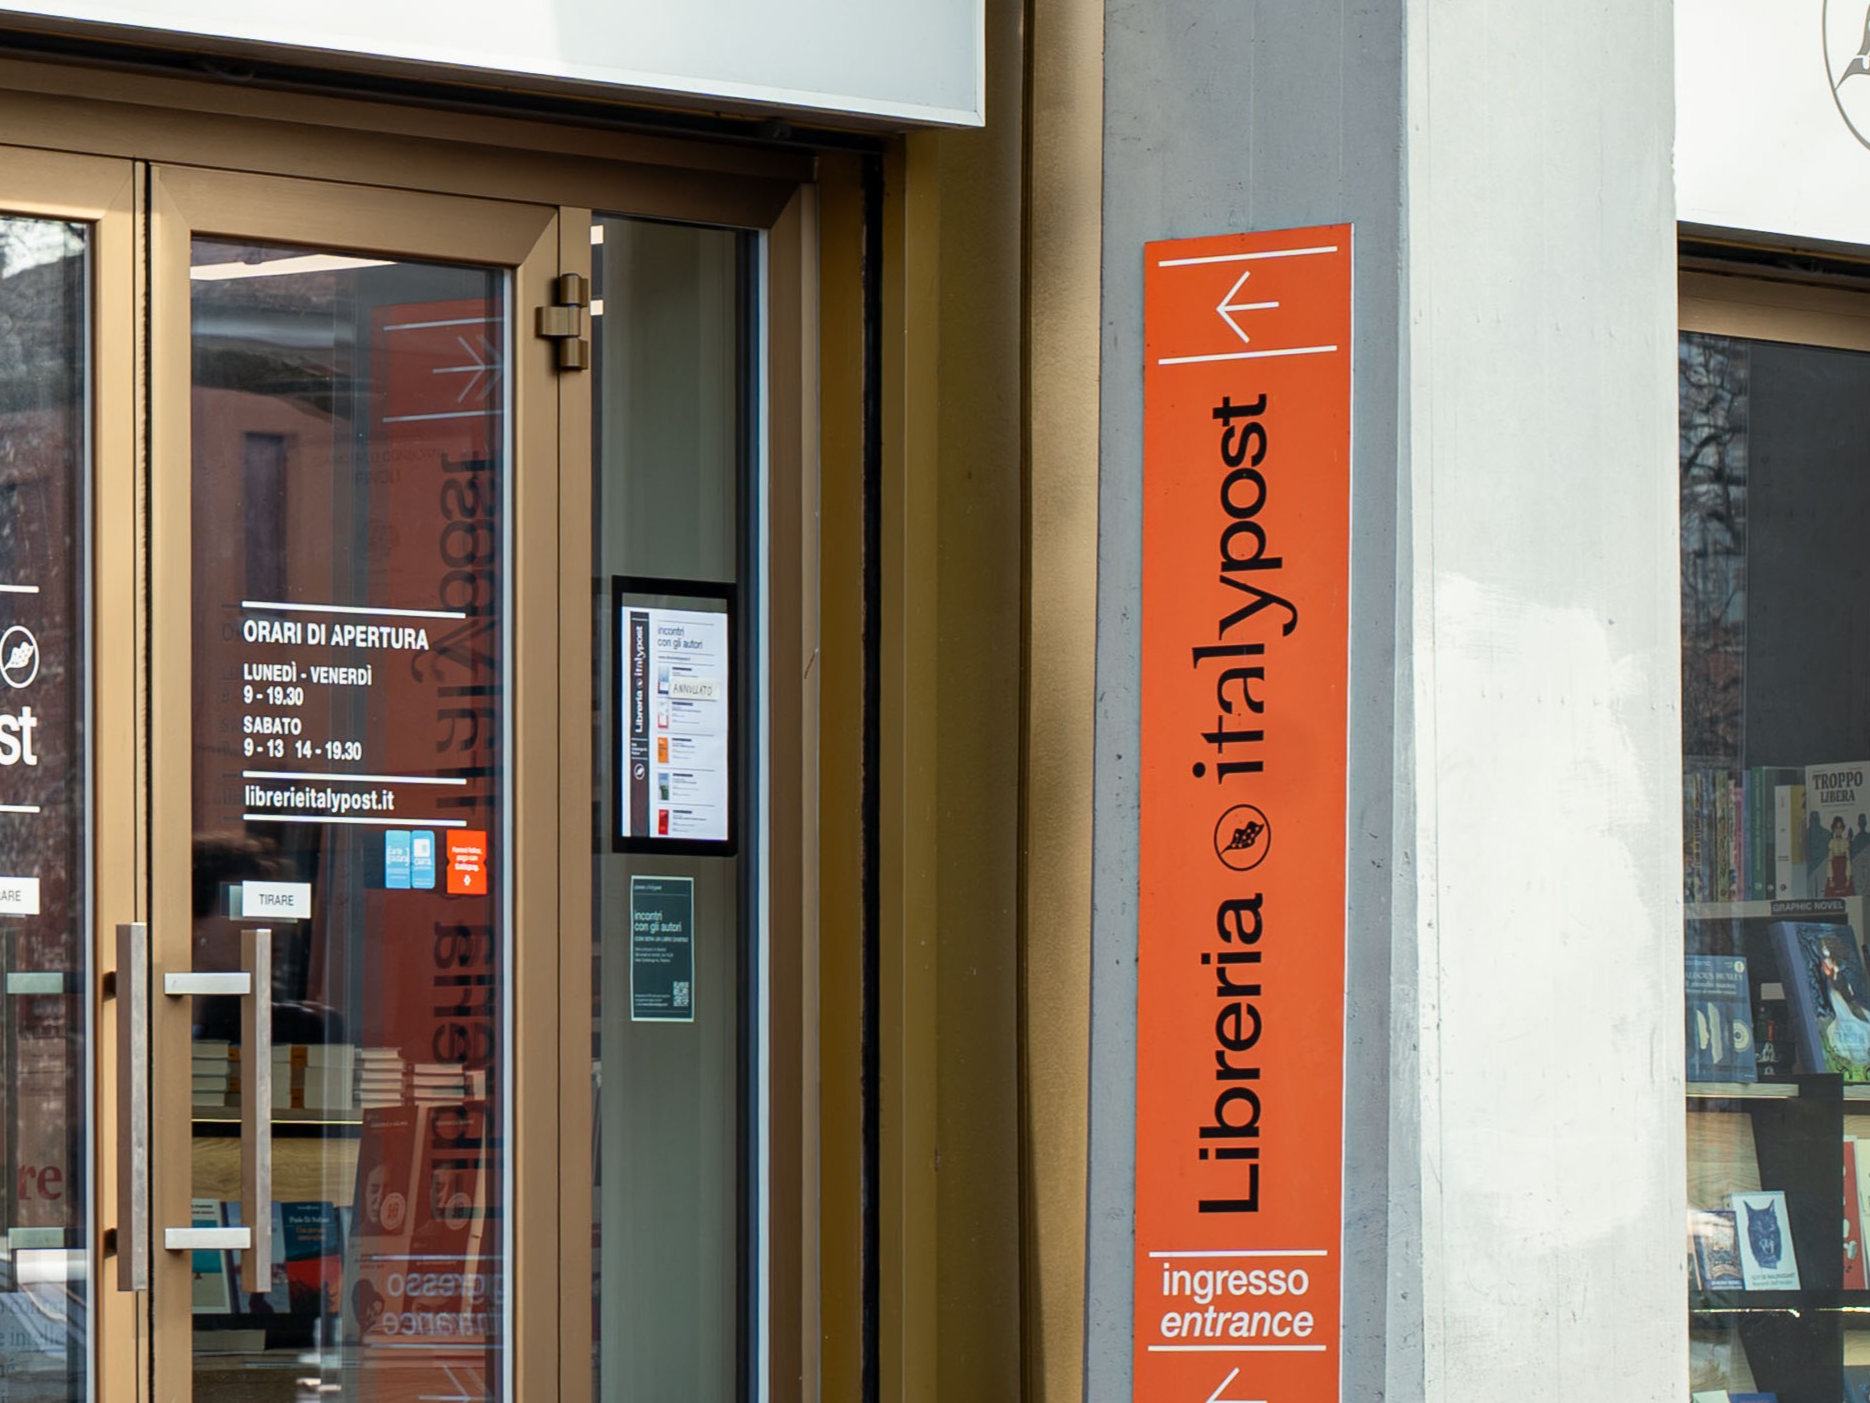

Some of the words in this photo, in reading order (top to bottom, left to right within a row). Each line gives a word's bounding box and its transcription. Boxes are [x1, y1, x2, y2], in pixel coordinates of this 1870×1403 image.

[1191, 393, 1298, 786] italypost
[243, 619, 302, 645] ORARI
[307, 623, 326, 646] DI
[330, 624, 429, 650] APERTURA
[657, 624, 685, 637] incontri
[634, 626, 648, 677] italypost
[657, 639, 671, 648] con
[672, 637, 682, 650] gli
[683, 639, 704, 650] autori
[244, 660, 297, 682] LUNEDÌ
[310, 664, 373, 686] VENERDÌ
[243, 686, 254, 704] 9
[266, 687, 304, 706] 19.30
[634, 689, 645, 734] Libreria
[243, 715, 302, 736] SABATO
[243, 738, 254, 757] 9
[266, 739, 285, 758] 13
[294, 740, 312, 759] 14
[324, 741, 362, 761] 19.30
[1812, 771, 1864, 791] TROPPO
[245, 785, 395, 813] librerieitalypost.it
[1820, 789, 1856, 804] LIBERA
[258, 893, 295, 907] TIRARE
[1772, 901, 1812, 913] GRAPHIC
[1814, 899, 1844, 911] NOVEL
[634, 910, 663, 921] incontri
[634, 922, 648, 932] con
[650, 922, 659, 934] gli
[661, 922, 682, 933] autori
[1198, 892, 1264, 1214] Libreria
[1162, 1261, 1309, 1305] ingresso
[1160, 1305, 1314, 1339] entrance
